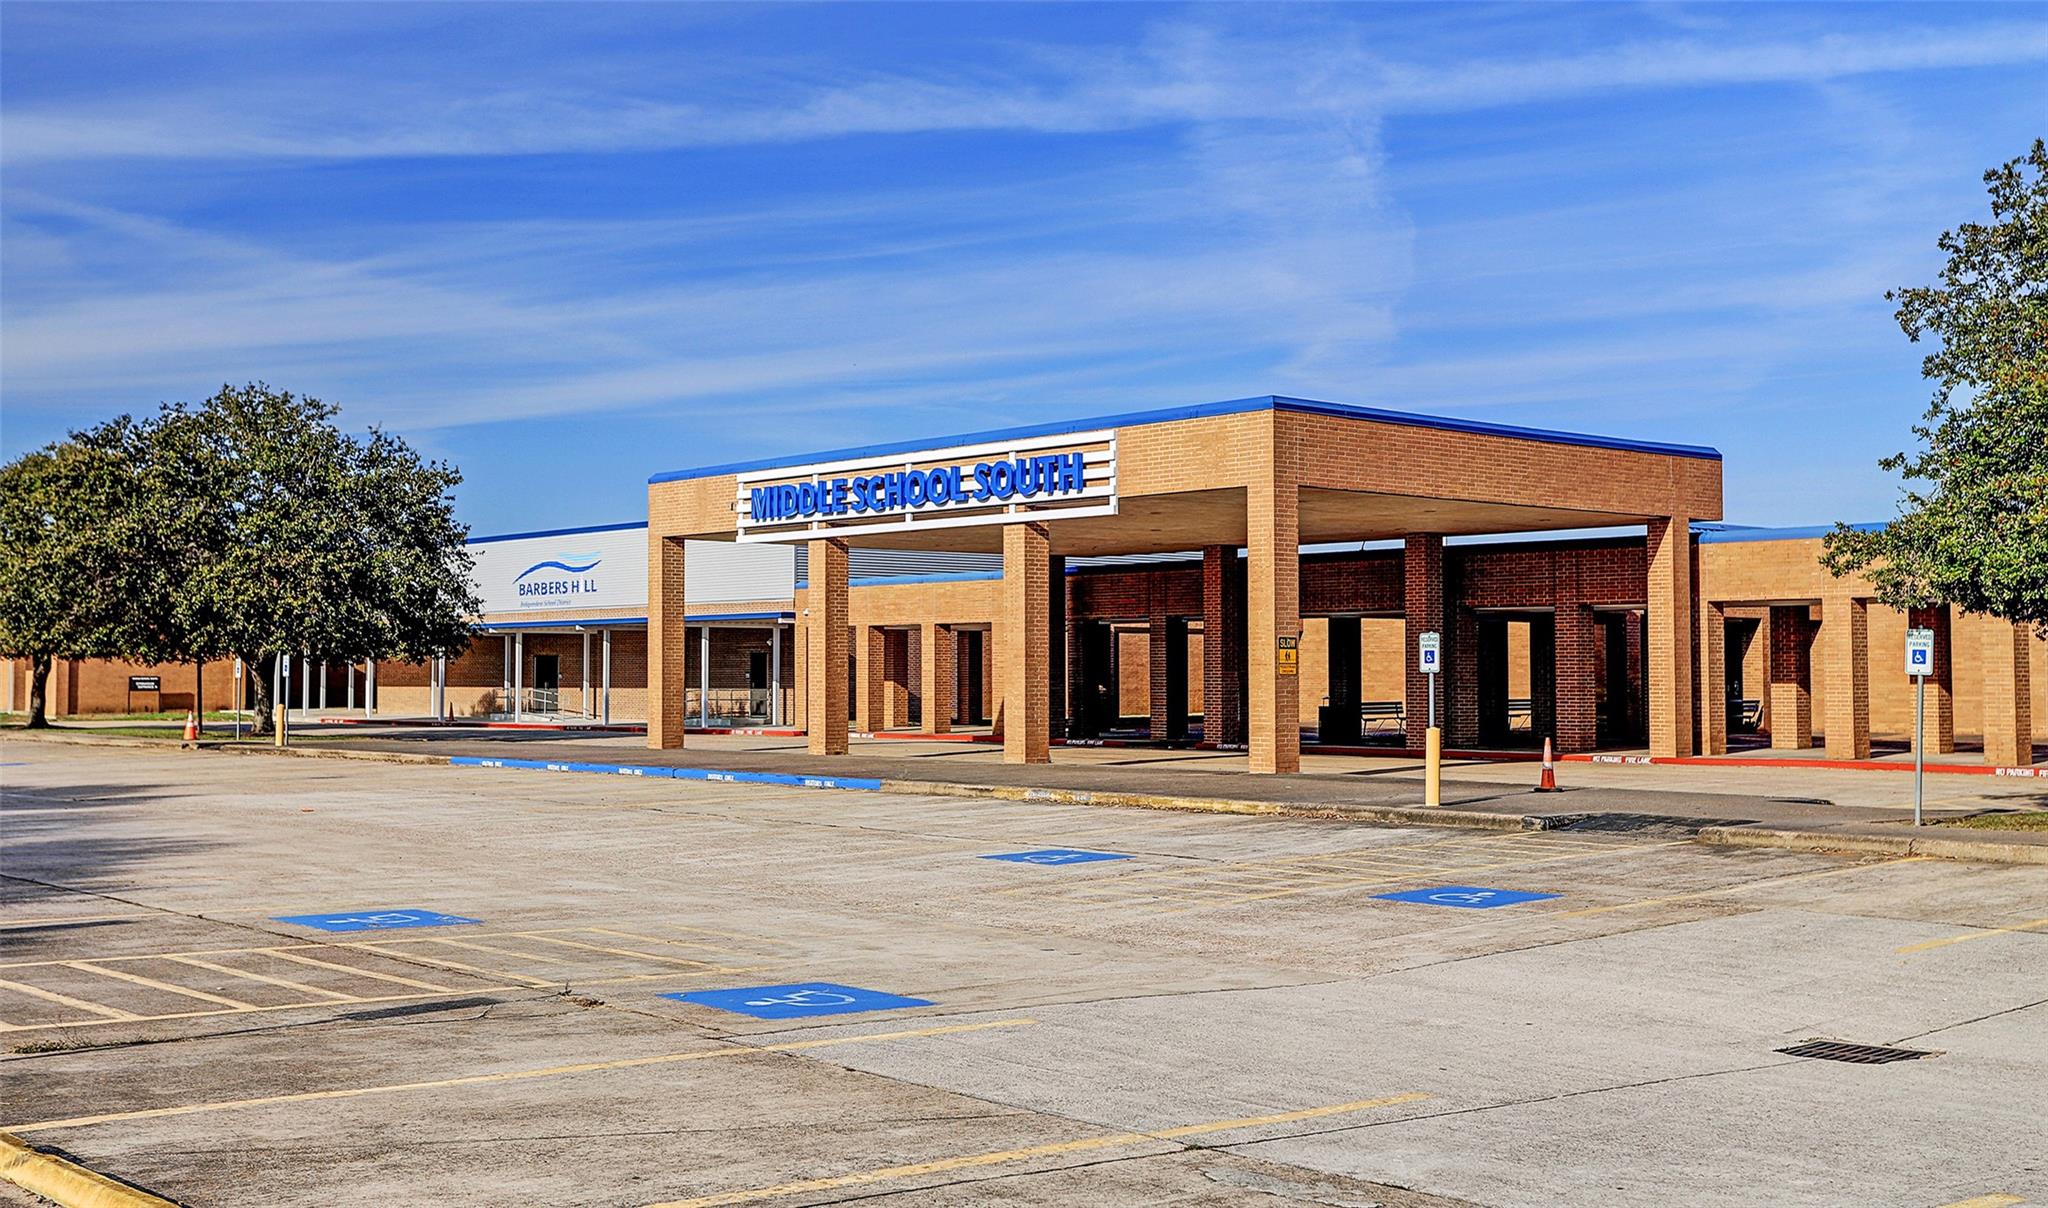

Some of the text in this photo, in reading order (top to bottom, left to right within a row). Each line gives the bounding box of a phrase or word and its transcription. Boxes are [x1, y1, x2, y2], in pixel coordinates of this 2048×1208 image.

[751, 452, 1084, 521] MIDDLE SCHOOL SOUTH
[519, 581, 568, 596] BARBERS
[1280, 638, 1296, 648] SLOW
[1996, 767, 2005, 776] NO
[2006, 767, 2034, 777] PARKING
